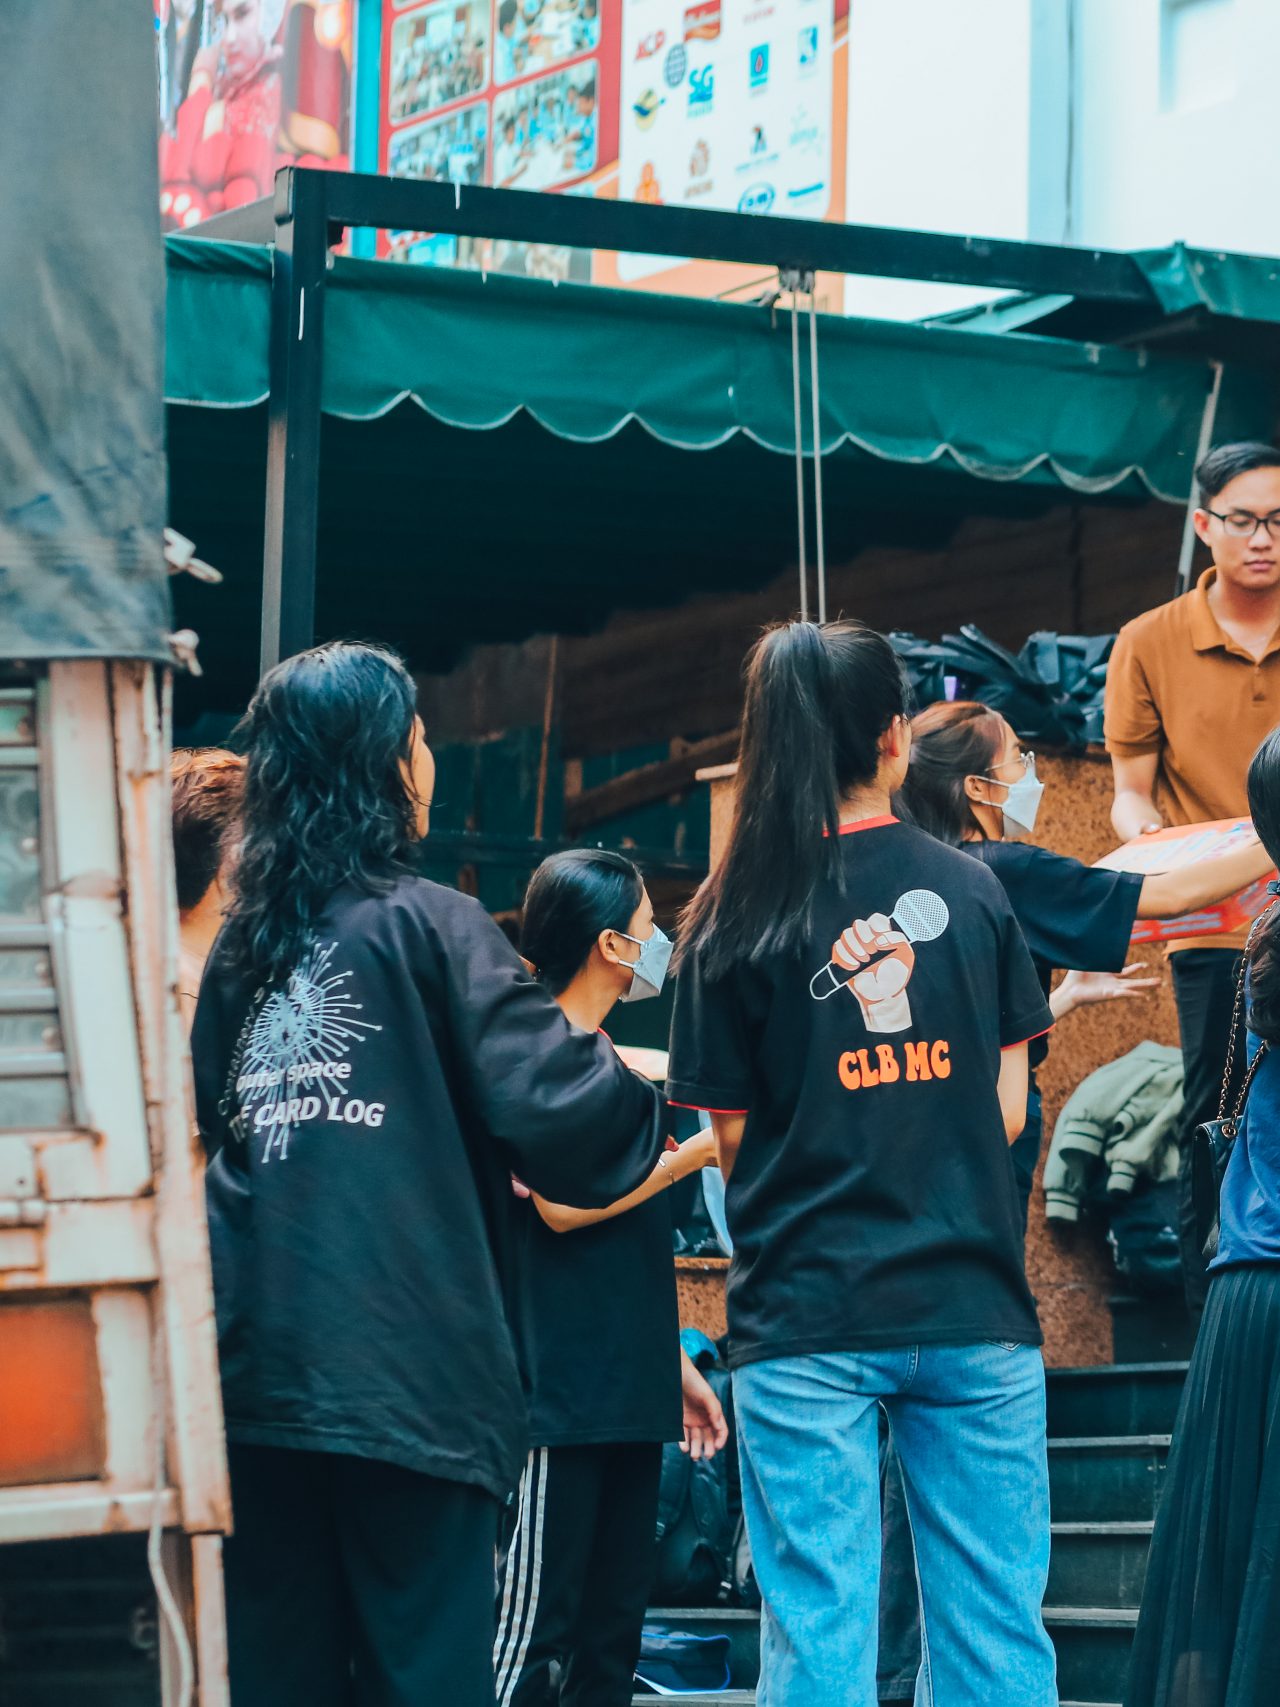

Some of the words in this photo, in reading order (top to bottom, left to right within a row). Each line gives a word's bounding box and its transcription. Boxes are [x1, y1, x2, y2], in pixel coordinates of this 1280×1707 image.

[287, 1061, 352, 1086] space
[838, 1044, 900, 1091] CLB
[903, 1039, 951, 1082] MC
[254, 1096, 322, 1127] CARD
[327, 1096, 386, 1128] LOG
